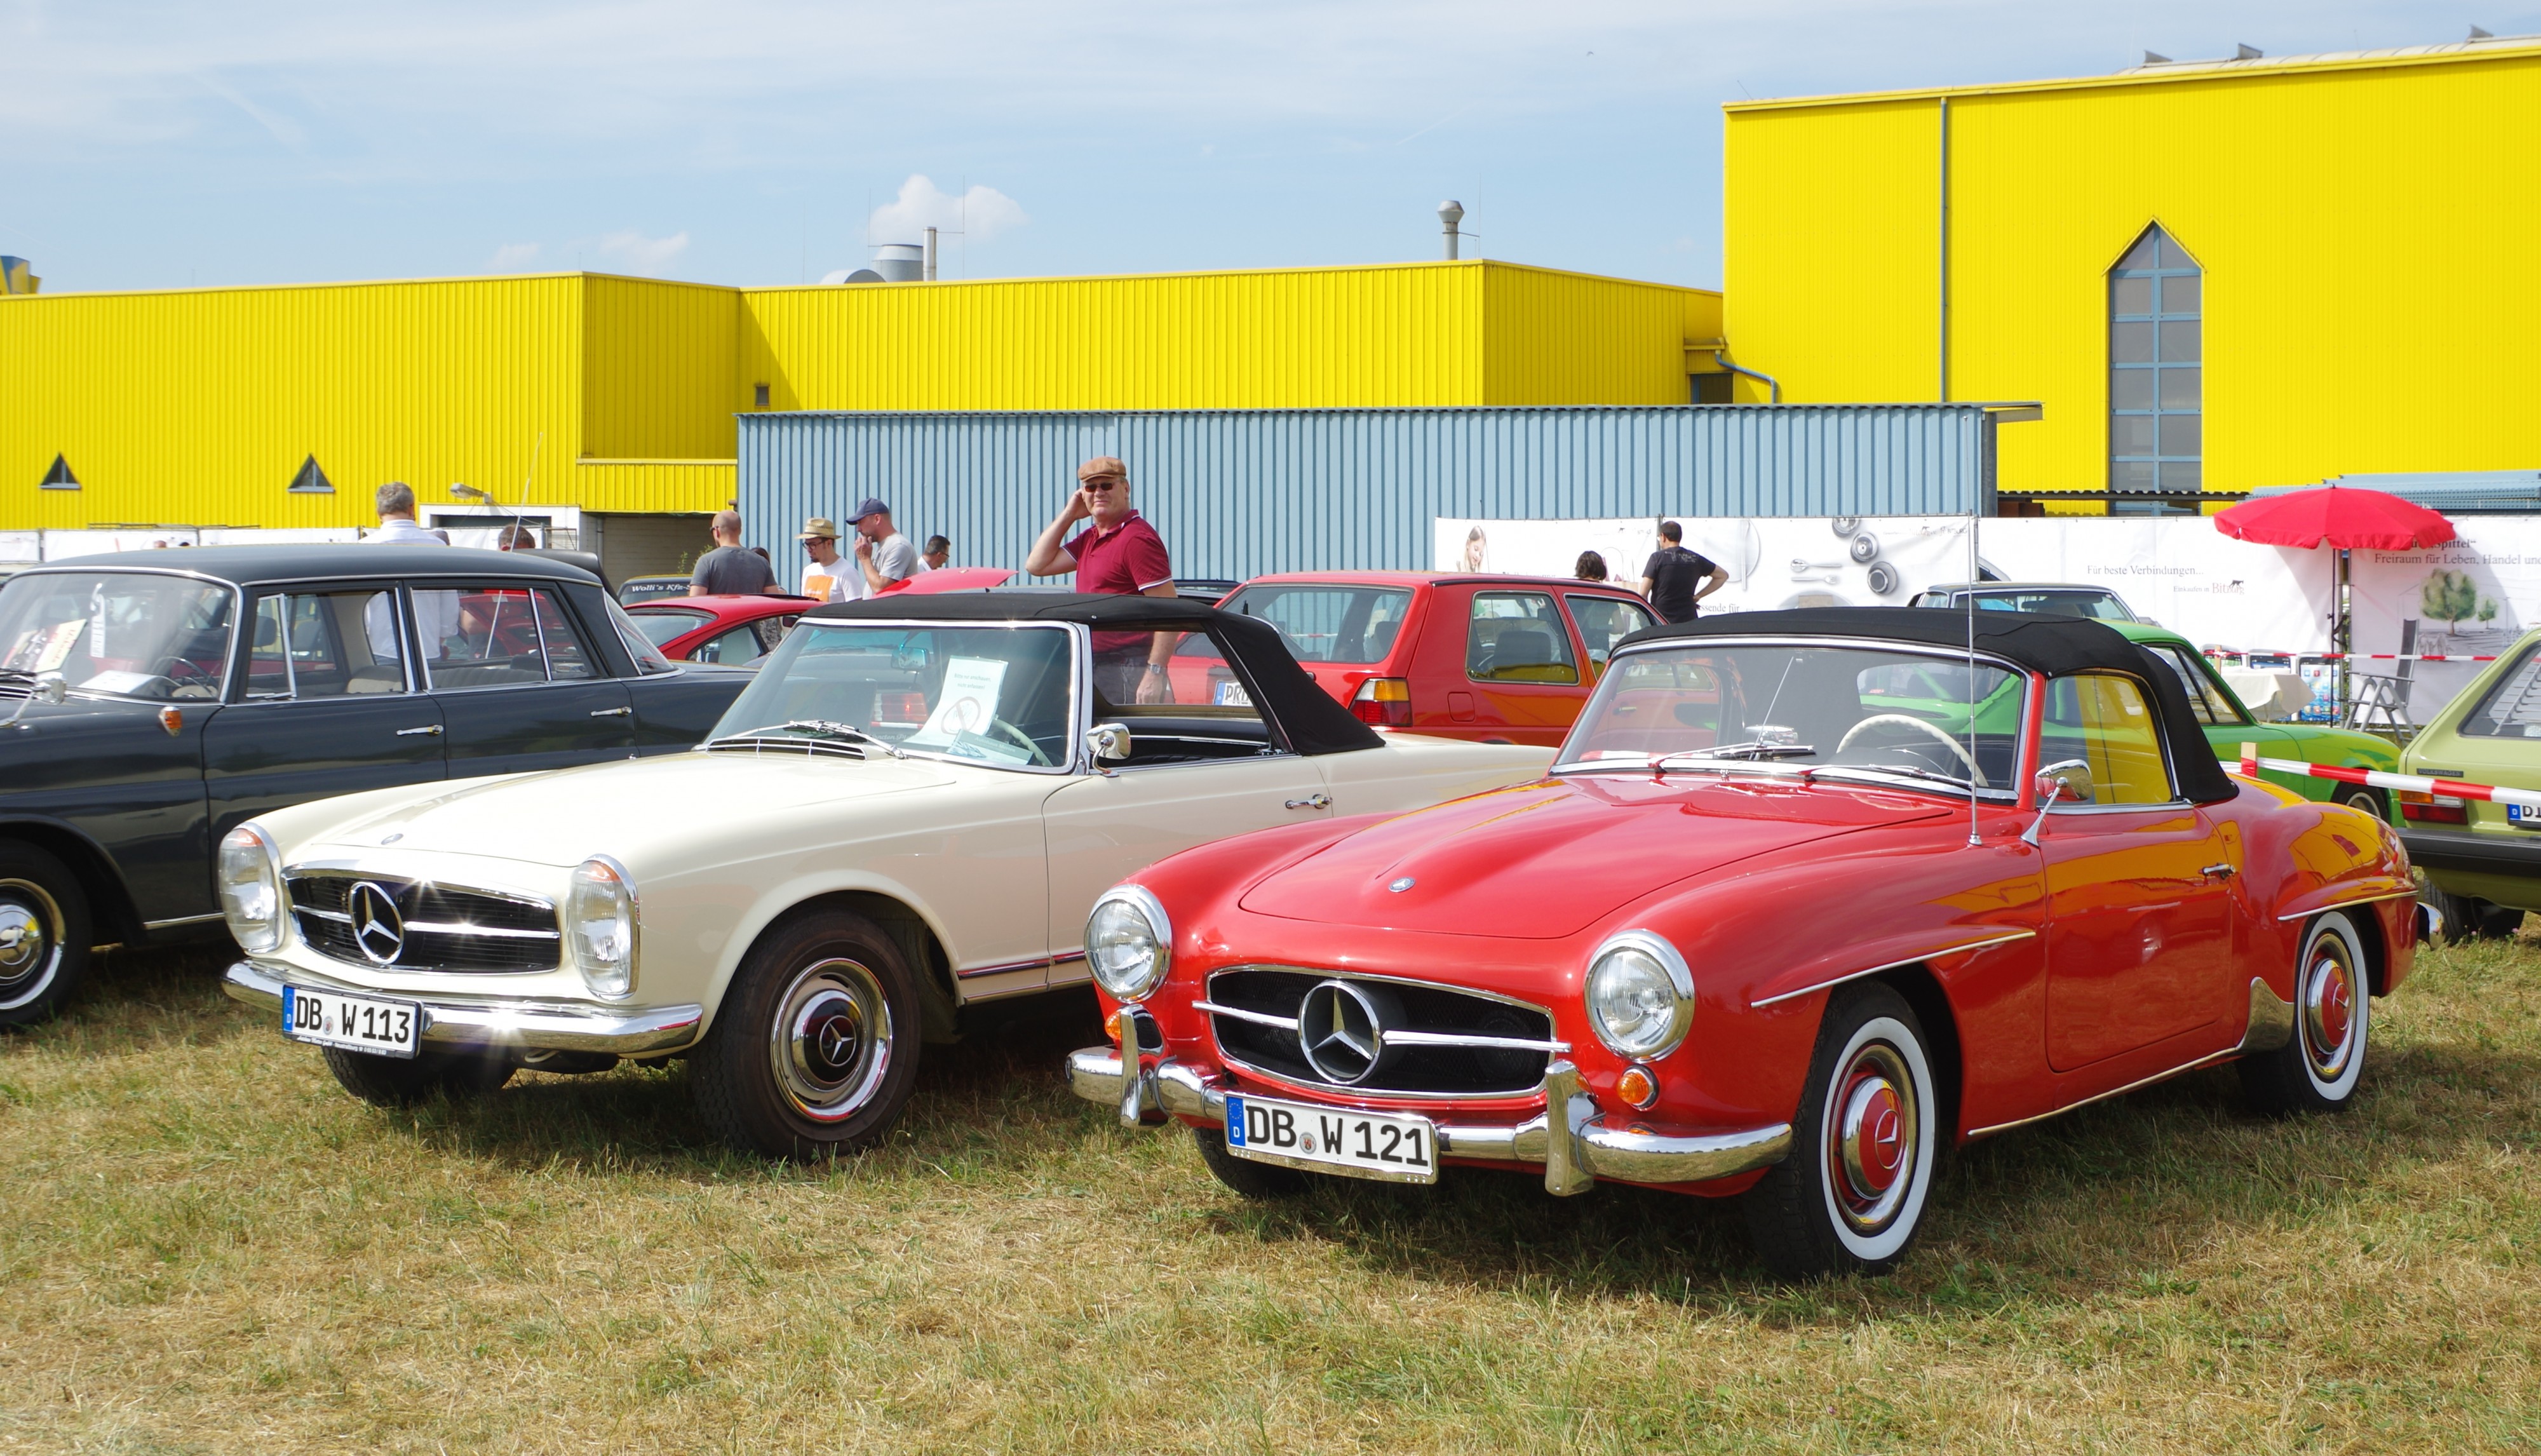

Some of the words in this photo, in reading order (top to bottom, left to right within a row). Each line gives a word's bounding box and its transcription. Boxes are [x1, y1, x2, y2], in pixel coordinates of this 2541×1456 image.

[2375, 553, 2422, 564] Freiraum
[2425, 553, 2441, 564] für
[2444, 554, 2479, 565] Leben,
[2483, 554, 2521, 565] Handel
[2087, 565, 2101, 575] Für
[2104, 565, 2127, 575] beste
[2130, 565, 2204, 577] Verbindungen...
[2418, 768, 2462, 777] VOLKSWAGEN
[295, 995, 322, 1031] DB
[342, 1003, 357, 1037] W
[362, 1007, 410, 1044] 113
[1232, 1126, 1240, 1138] D
[1245, 1105, 1297, 1148] DB
[1320, 1115, 1343, 1155] W
[1354, 1121, 1429, 1167] 121
